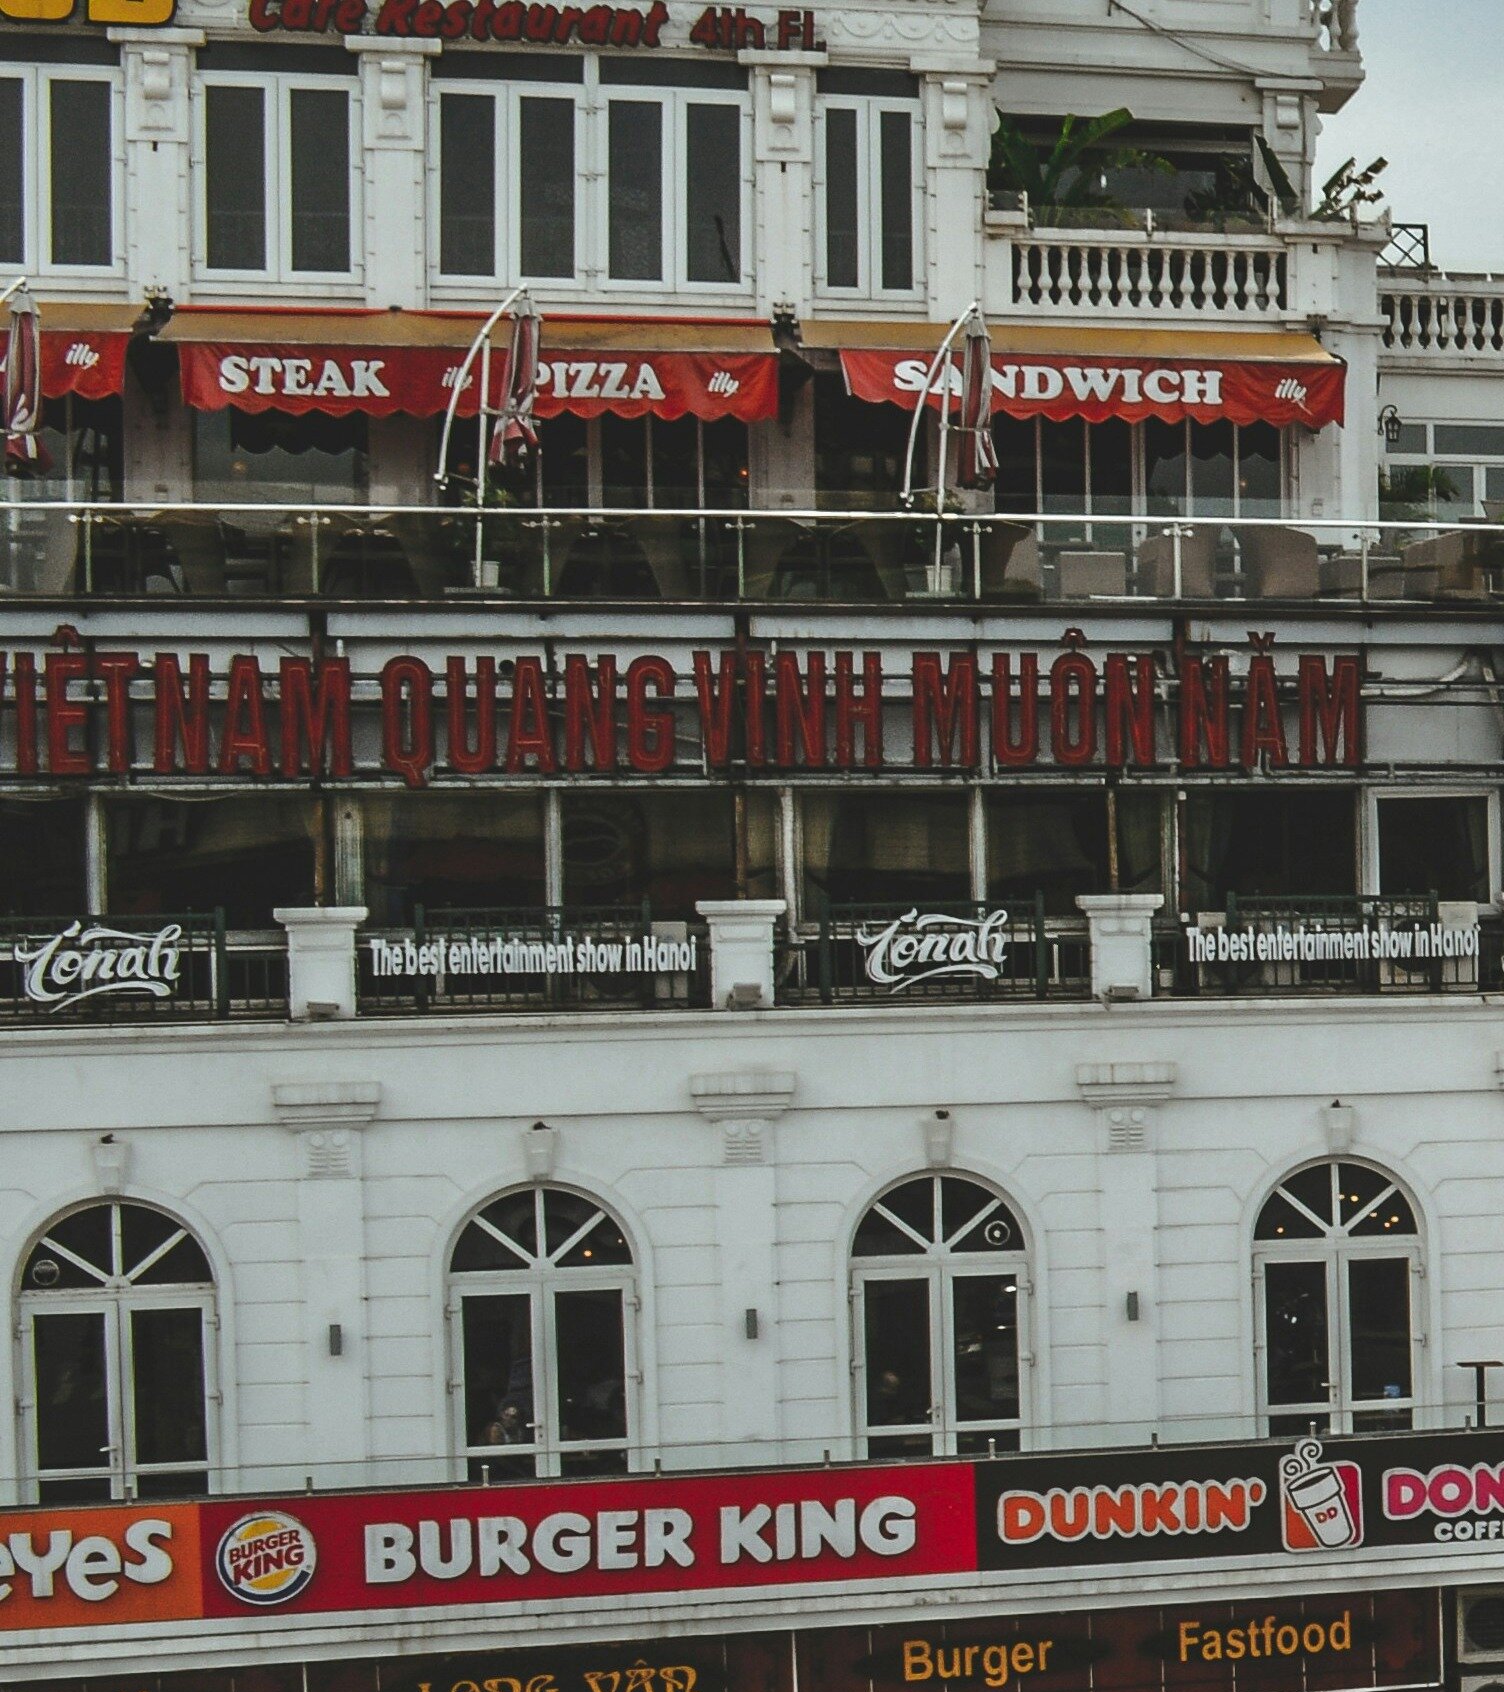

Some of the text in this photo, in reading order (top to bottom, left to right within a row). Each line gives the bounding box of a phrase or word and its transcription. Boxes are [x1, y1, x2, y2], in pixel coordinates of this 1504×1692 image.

[376, 0, 669, 47] Restaurant
[689, 5, 766, 48] 4th
[65, 342, 99, 371] illy
[218, 354, 391, 399] STEAK
[534, 360, 666, 400] PIZZA
[706, 369, 741, 398] illy
[893, 357, 1223, 405] SANDWICH
[1273, 377, 1312, 414] illy
[154, 653, 353, 778] NAM
[381, 654, 678, 790] QUANG
[692, 648, 885, 768] VINH
[911, 627, 1157, 768] MUÔN
[1179, 630, 1364, 769] NĂM
[370, 934, 697, 976] The best entertainment show in Hanoi
[1187, 923, 1480, 962] The best entertainment show in Hanoi
[998, 1475, 1267, 1546] DUNKIN'
[229, 1529, 301, 1565] BURGER
[363, 1494, 917, 1585] BURGER KING
[232, 1544, 305, 1587] KING
[1177, 1609, 1355, 1663] Fastfood
[901, 1634, 1054, 1688] Burger
